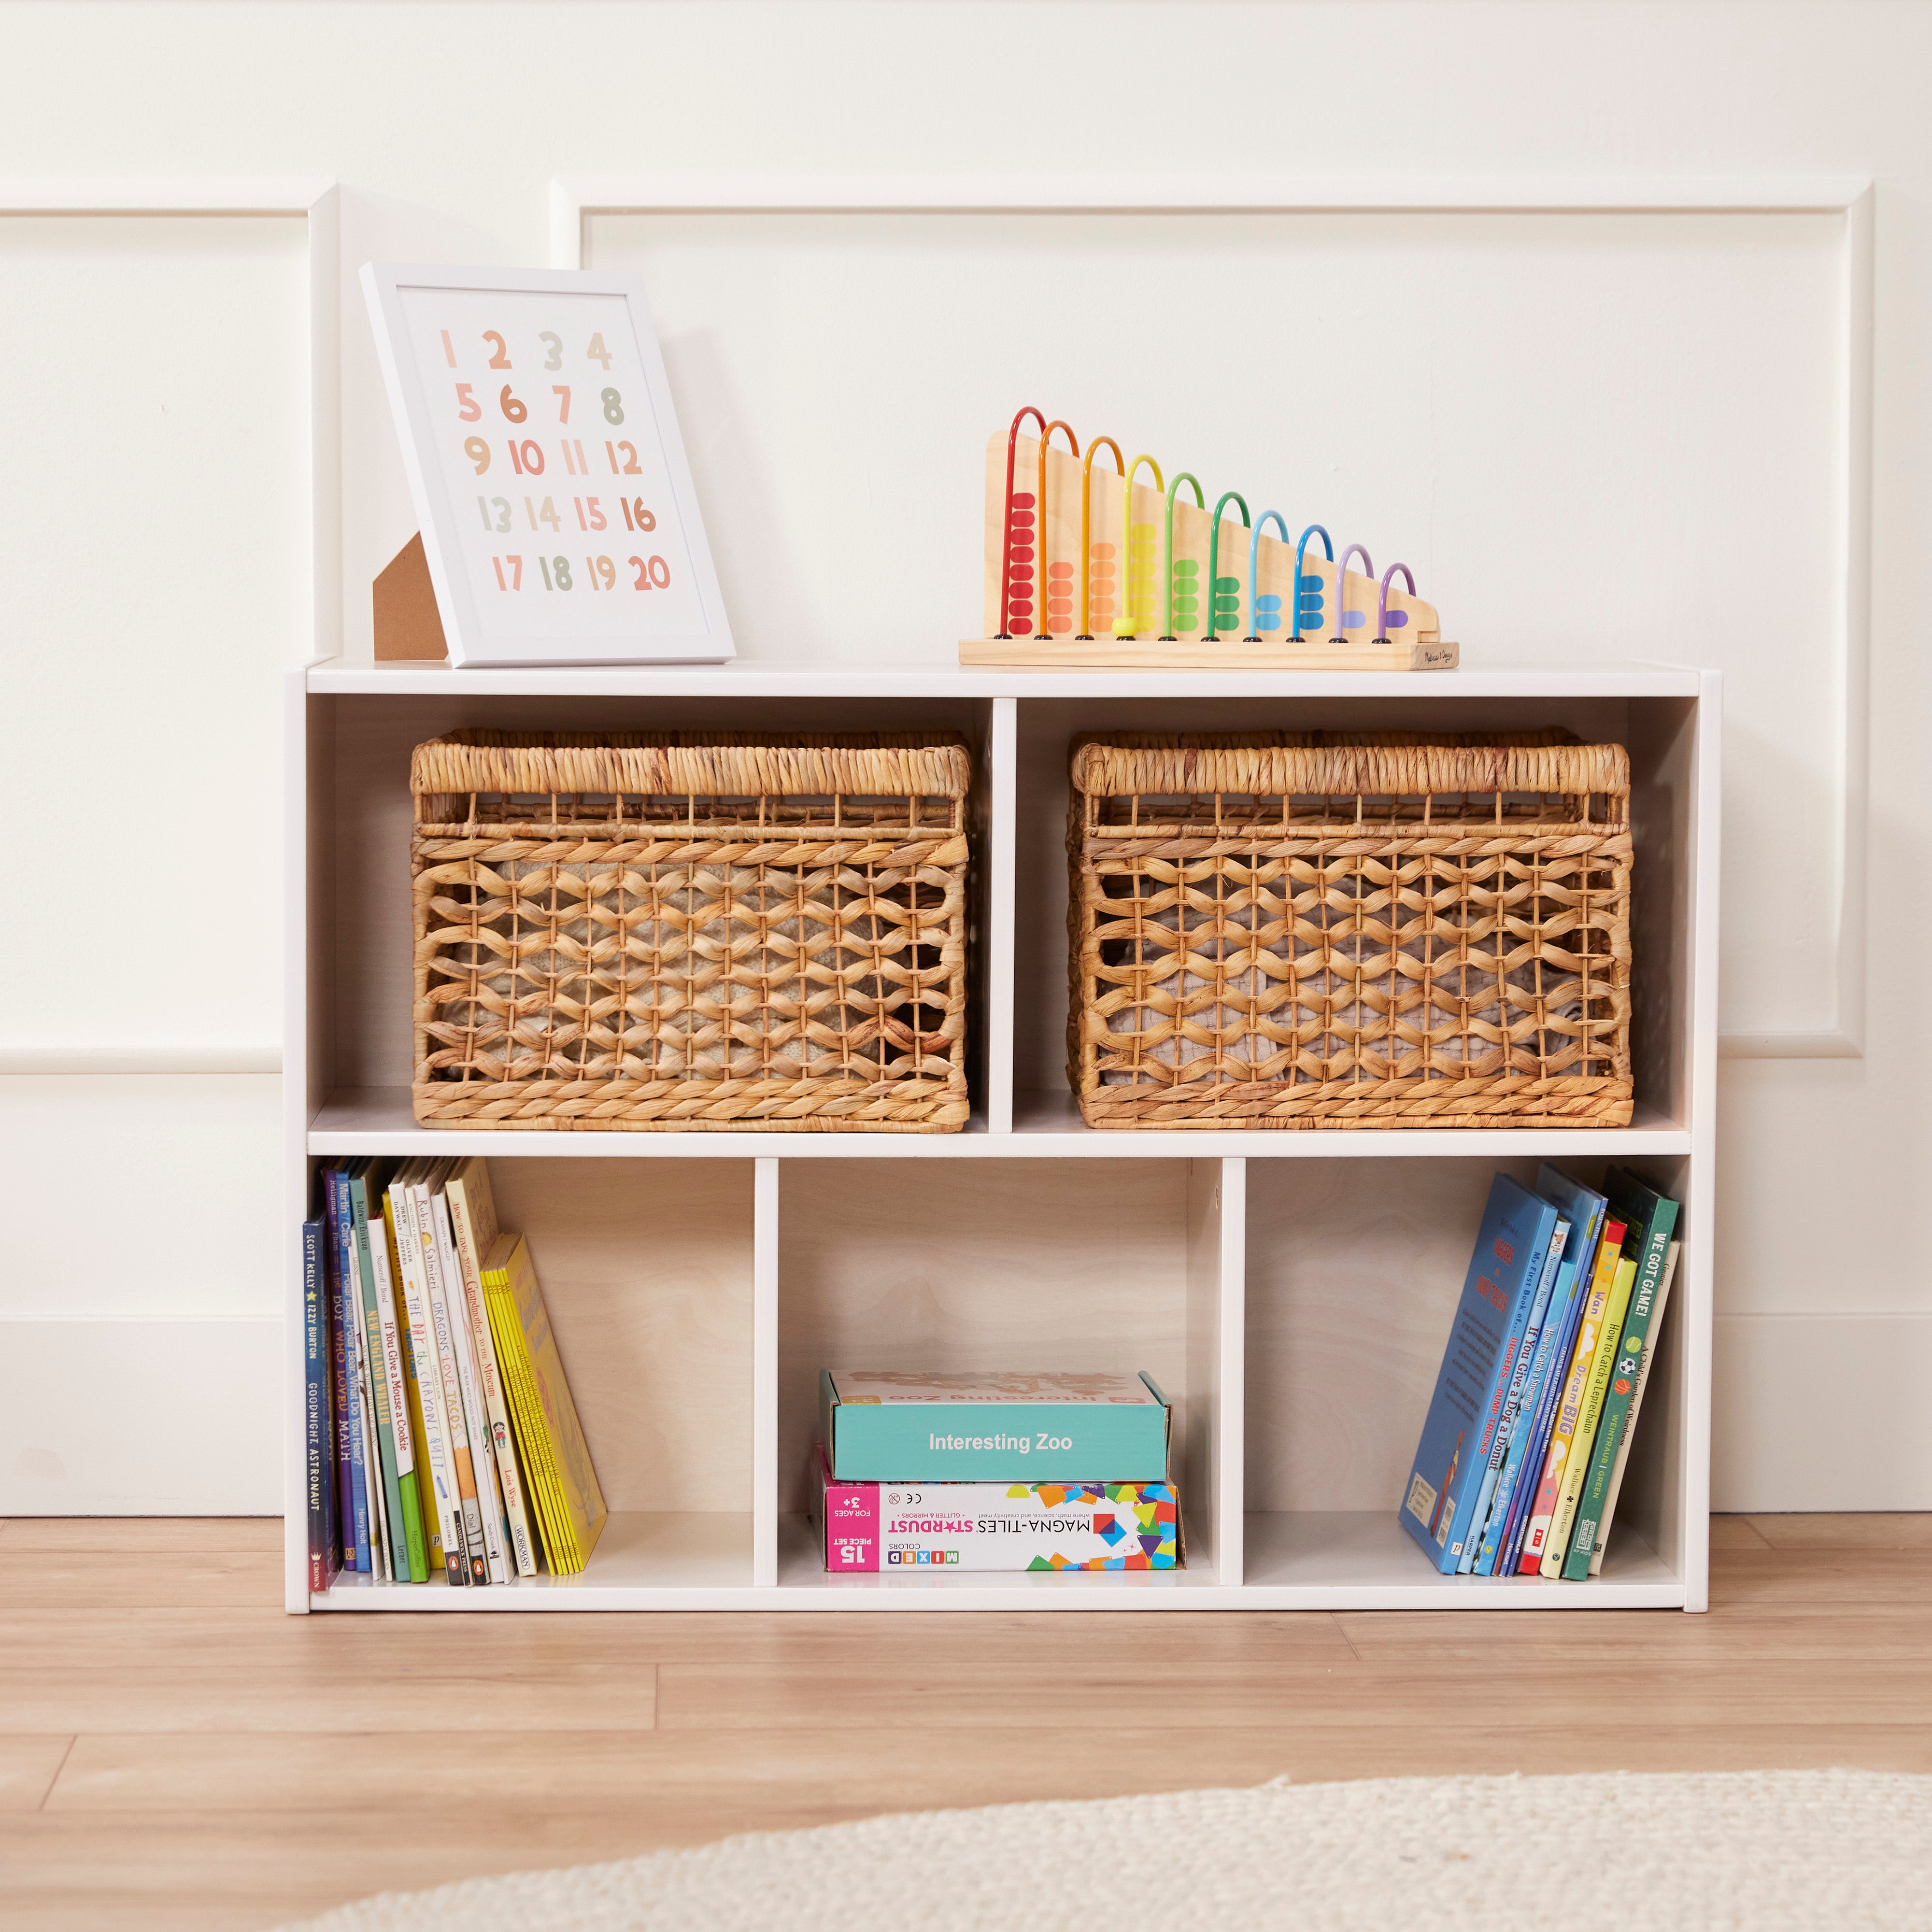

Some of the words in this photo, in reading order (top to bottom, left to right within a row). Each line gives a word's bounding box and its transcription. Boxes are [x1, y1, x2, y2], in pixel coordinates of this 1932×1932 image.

[440, 329, 457, 368] 1
[482, 330, 512, 369] 2
[539, 330, 563, 371] 3
[586, 332, 612, 370] 4
[455, 383, 482, 422] 5
[500, 384, 528, 424] 6
[552, 385, 571, 425] 7
[601, 387, 625, 426] 8
[464, 436, 491, 476] 9
[508, 439, 545, 476] 10
[560, 439, 589, 475] 11
[605, 440, 643, 475] 12
[477, 496, 512, 533] 13
[524, 496, 562, 532] 14
[573, 497, 608, 531] 15
[620, 497, 656, 532] 16
[492, 555, 523, 591] 17
[539, 555, 573, 591] 18
[586, 555, 616, 591] 19
[628, 555, 670, 591] 20
[339, 1183, 350, 1213] Martin
[453, 1203, 462, 1220] HOW
[341, 1222, 351, 1247] Carle
[394, 1201, 402, 1230] DAYWALT
[399, 1238, 407, 1265] JEFFERS
[456, 1222, 465, 1234] TO
[306, 1235, 314, 1261] SCOTT
[417, 1199, 431, 1228] Rubin
[424, 1248, 440, 1289] Salmieri
[459, 1236, 469, 1254] TAKE
[1651, 1231, 1666, 1251] WE
[376, 1255, 385, 1282] Numeroff
[463, 1257, 473, 1278] YOUR
[1531, 1251, 1541, 1264] My
[1645, 1252, 1661, 1277] GOT
[306, 1264, 315, 1288] KELLY
[1525, 1266, 1536, 1287] First
[1542, 1255, 1557, 1286] Numeroff
[1658, 1262, 1670, 1286] Gautier
[343, 1273, 352, 1296] Polar
[408, 1296, 422, 1318] THE
[466, 1280, 486, 1335] Grandmother
[1519, 1290, 1530, 1310] Book
[1536, 1290, 1547, 1307] Bond
[1591, 1290, 1605, 1315] Wan
[1635, 1278, 1655, 1317] GAME!
[307, 1305, 315, 1324] IZZY
[367, 1310, 380, 1332] NEW
[384, 1321, 394, 1330] If
[432, 1301, 449, 1351] DRAGONS
[308, 1327, 317, 1359] BURTON
[346, 1325, 355, 1348] Polar
[386, 1331, 396, 1348] You
[410, 1323, 426, 1345] DAY
[479, 1338, 485, 1346] TO
[1527, 1326, 1539, 1336] If
[1542, 1328, 1554, 1344] How
[1606, 1323, 1619, 1342] How
[335, 1330, 345, 1363] WHO
[369, 1334, 386, 1381] ENGLAND
[415, 1350, 428, 1365] the
[1500, 1336, 1518, 1378] DIGGERS
[1520, 1337, 1535, 1360] You
[1540, 1344, 1548, 1352] to
[1604, 1343, 1614, 1353] to
[388, 1350, 398, 1370] Give
[441, 1357, 454, 1386] LOVE
[1534, 1353, 1548, 1373] Catch
[1597, 1354, 1611, 1378] Catch
[1635, 1353, 1648, 1378] Child's
[349, 1376, 359, 1399] What
[482, 1363, 498, 1397] Museum
[1512, 1362, 1528, 1389] Give
[1568, 1364, 1587, 1404] Dream
[337, 1370, 348, 1411] LOVED
[392, 1380, 404, 1410] Mouse
[419, 1371, 438, 1430] CRAYONS
[1490, 1388, 1504, 1415] DUMP
[1509, 1390, 1518, 1398] a
[1523, 1378, 1540, 1412] Snowman
[1629, 1378, 1642, 1404] Garden
[351, 1402, 360, 1416] Do
[375, 1383, 391, 1424] WHALER
[446, 1391, 461, 1430] TACOS
[1500, 1399, 1518, 1424] Dog
[1581, 1385, 1603, 1435] Leprechaun
[1628, 1403, 1635, 1412] of
[352, 1418, 361, 1435] You
[1557, 1404, 1578, 1435] BIG
[1619, 1411, 1634, 1447] Weirdness
[340, 1420, 350, 1461] MATH
[397, 1419, 409, 1451] Cookie
[929, 1433, 1030, 1454] Interesting
[1036, 1434, 1072, 1449] Zoo
[1479, 1416, 1496, 1455] TRUCKS
[1601, 1414, 1619, 1464] WEINTRAUB
[352, 1438, 362, 1465] Hear?
[428, 1437, 444, 1469] QUIT
[1488, 1435, 1507, 1472] Donut
[310, 1449, 319, 1510] ASTRONAUT
[503, 1469, 514, 1486] Lois
[1502, 1463, 1516, 1489] Wallace
[1568, 1467, 1581, 1494] Wallace
[1592, 1469, 1605, 1498] GREEN
[507, 1487, 518, 1507] Wyse
[844, 1497, 860, 1508] 3+
[357, 1508, 366, 1527] Henry
[466, 1513, 476, 1528] Dial
[1492, 1499, 1506, 1527] Elkerton
[1558, 1504, 1572, 1534] Elkerton
[444, 1515, 453, 1546] PHILOMEL
[978, 1520, 1090, 1533] MAGNA-TILES
[411, 1531, 421, 1567] HarperCollins
[515, 1527, 529, 1567] WORKMAN
[840, 1545, 865, 1563] 15
[890, 1552, 958, 1563] MIXED
[1465, 1535, 1475, 1556] HARPER
[1503, 1542, 1513, 1565] Harcourt
